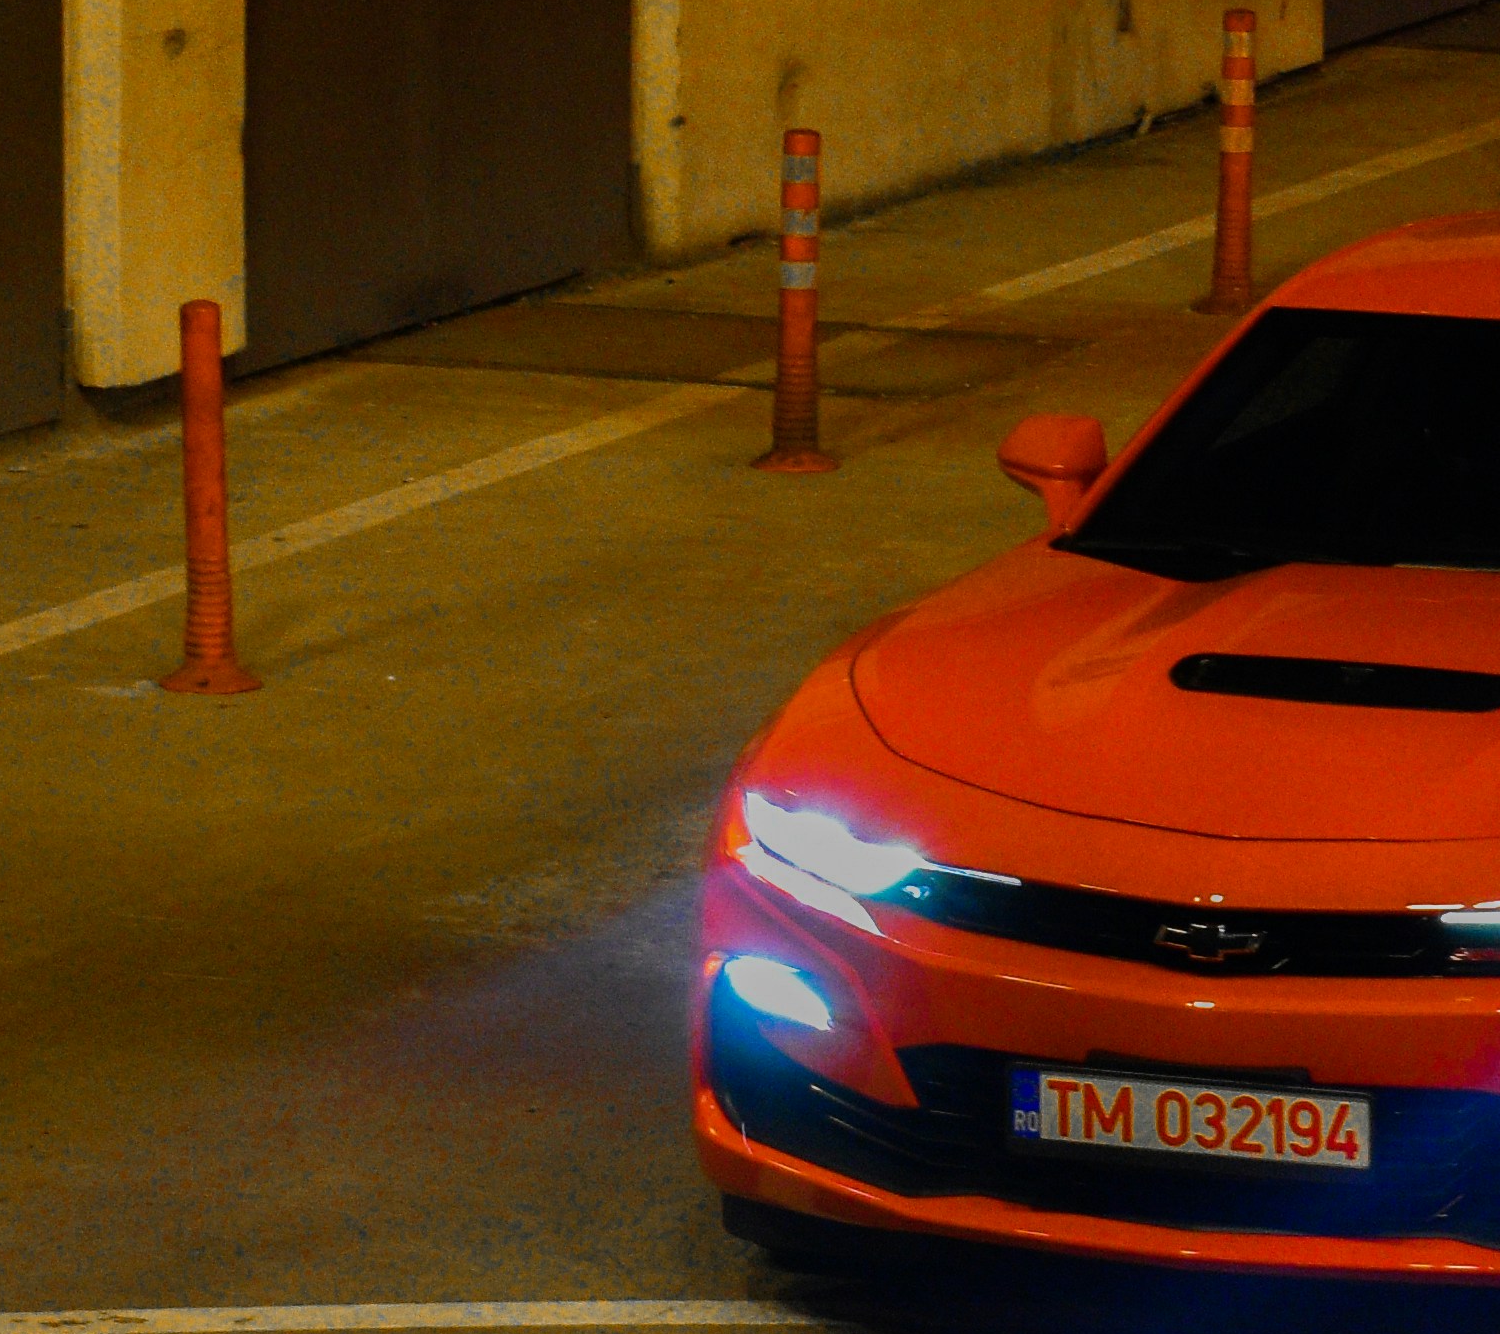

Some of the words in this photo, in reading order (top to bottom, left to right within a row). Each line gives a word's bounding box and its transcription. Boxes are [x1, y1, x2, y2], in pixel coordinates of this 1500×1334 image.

[1013, 1109, 1040, 1133] RO
[1046, 1078, 1134, 1144] TM
[1155, 1089, 1359, 1161] 032194
